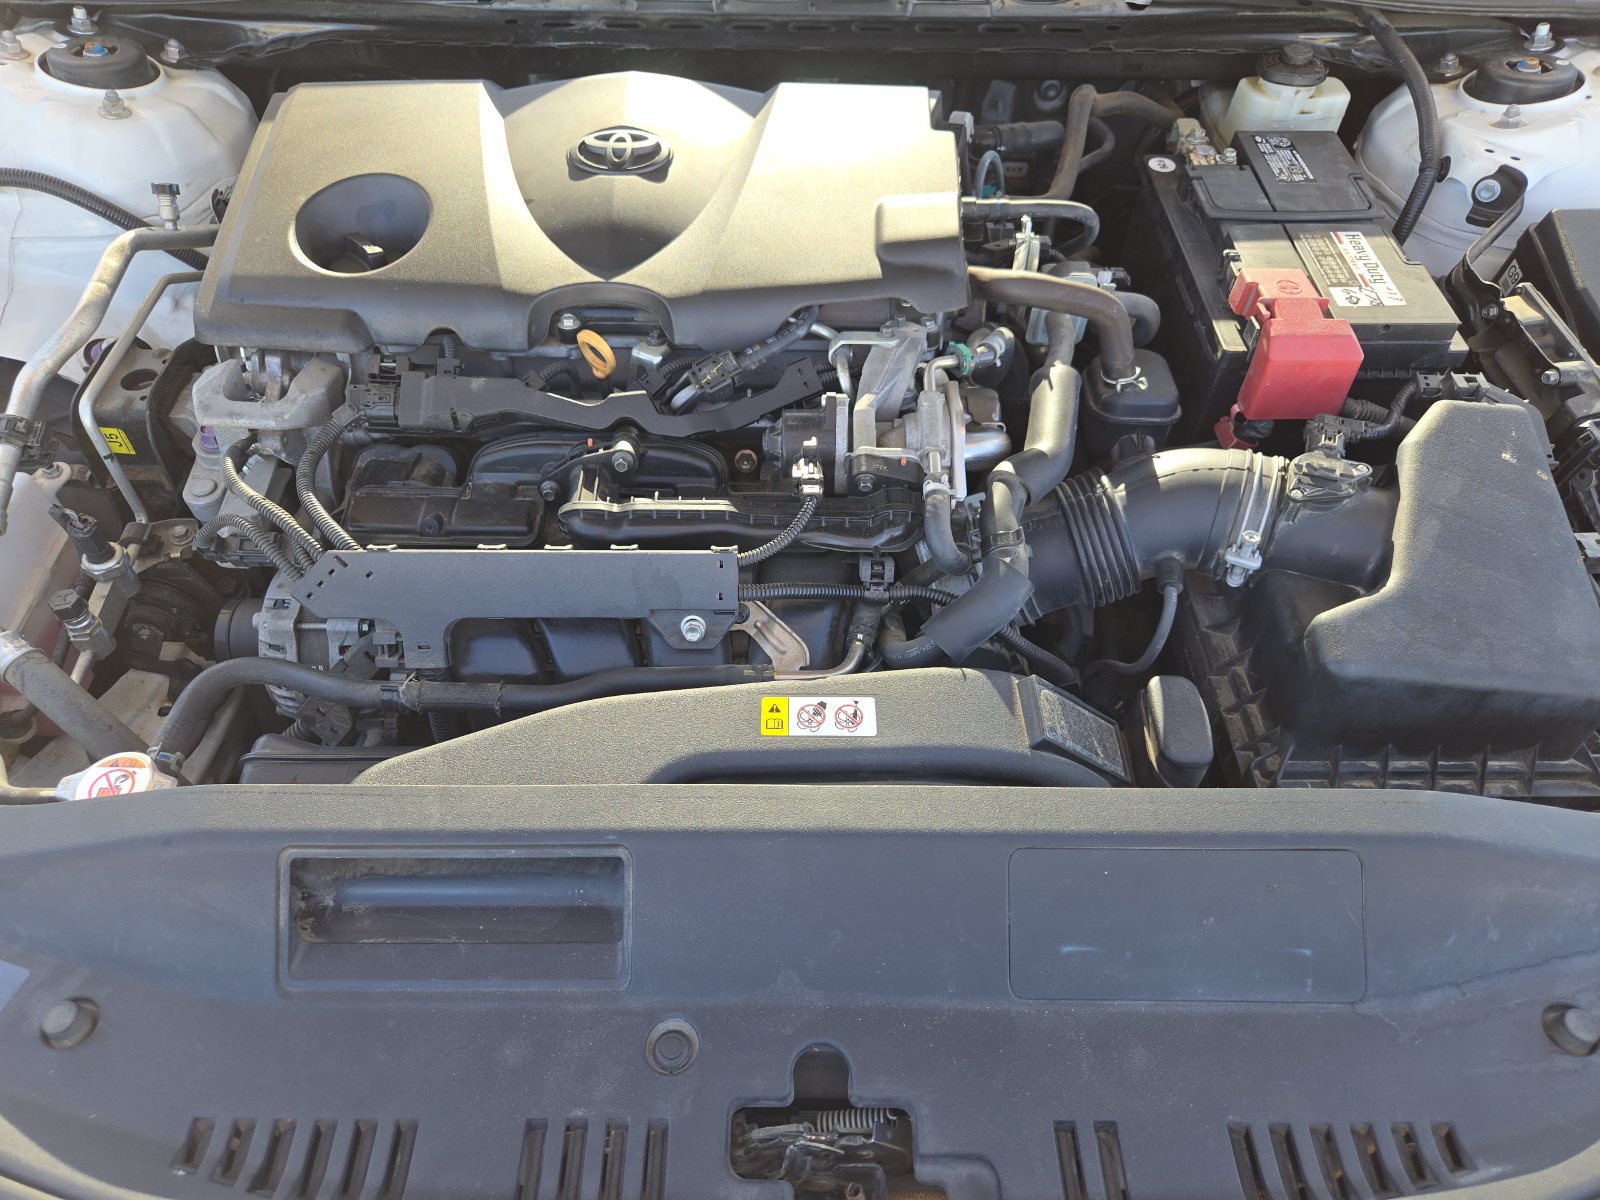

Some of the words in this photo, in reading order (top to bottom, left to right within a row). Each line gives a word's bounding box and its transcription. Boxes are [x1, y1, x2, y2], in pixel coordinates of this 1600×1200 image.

[1345, 234, 1371, 261] Heavy
[1363, 262, 1386, 284] Duty
[1508, 264, 1520, 285] G9
[104, 433, 122, 447] J5
